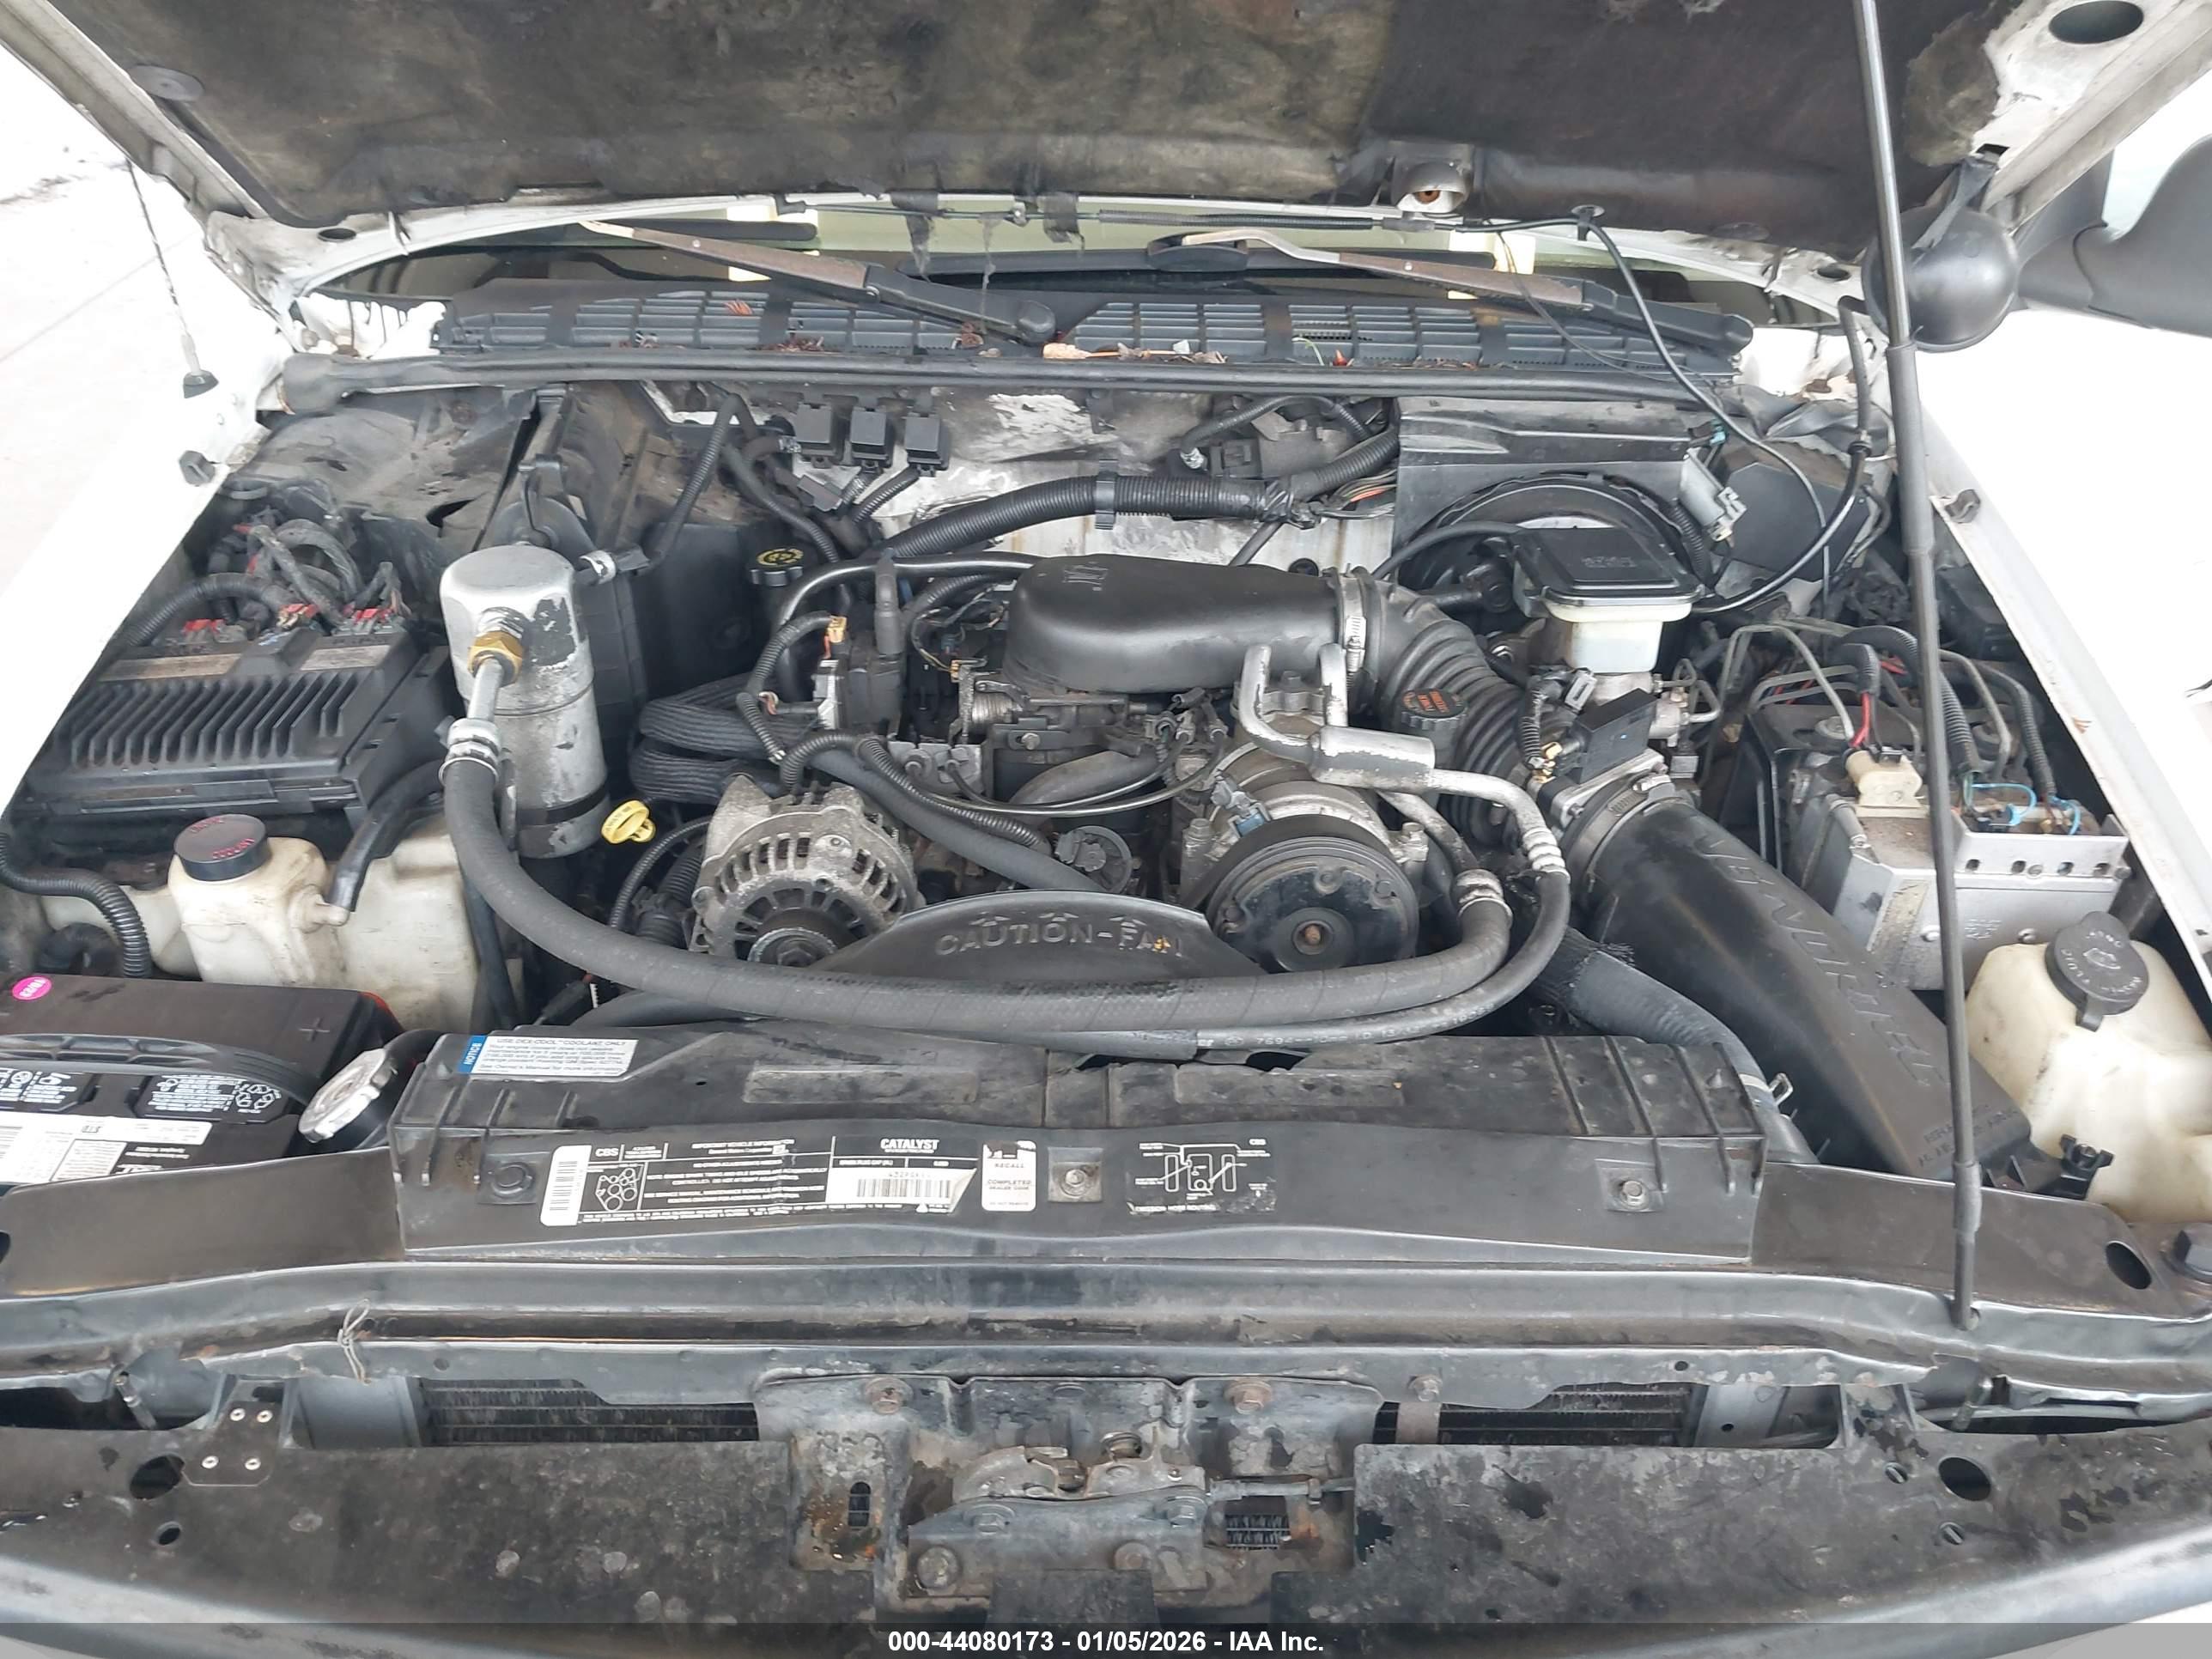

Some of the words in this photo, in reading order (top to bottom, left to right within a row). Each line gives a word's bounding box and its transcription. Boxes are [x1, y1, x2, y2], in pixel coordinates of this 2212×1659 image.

[463, 1042, 483, 1065] NOTICE
[880, 1138, 940, 1151] CATALYST
[595, 1147, 619, 1158] CBS
